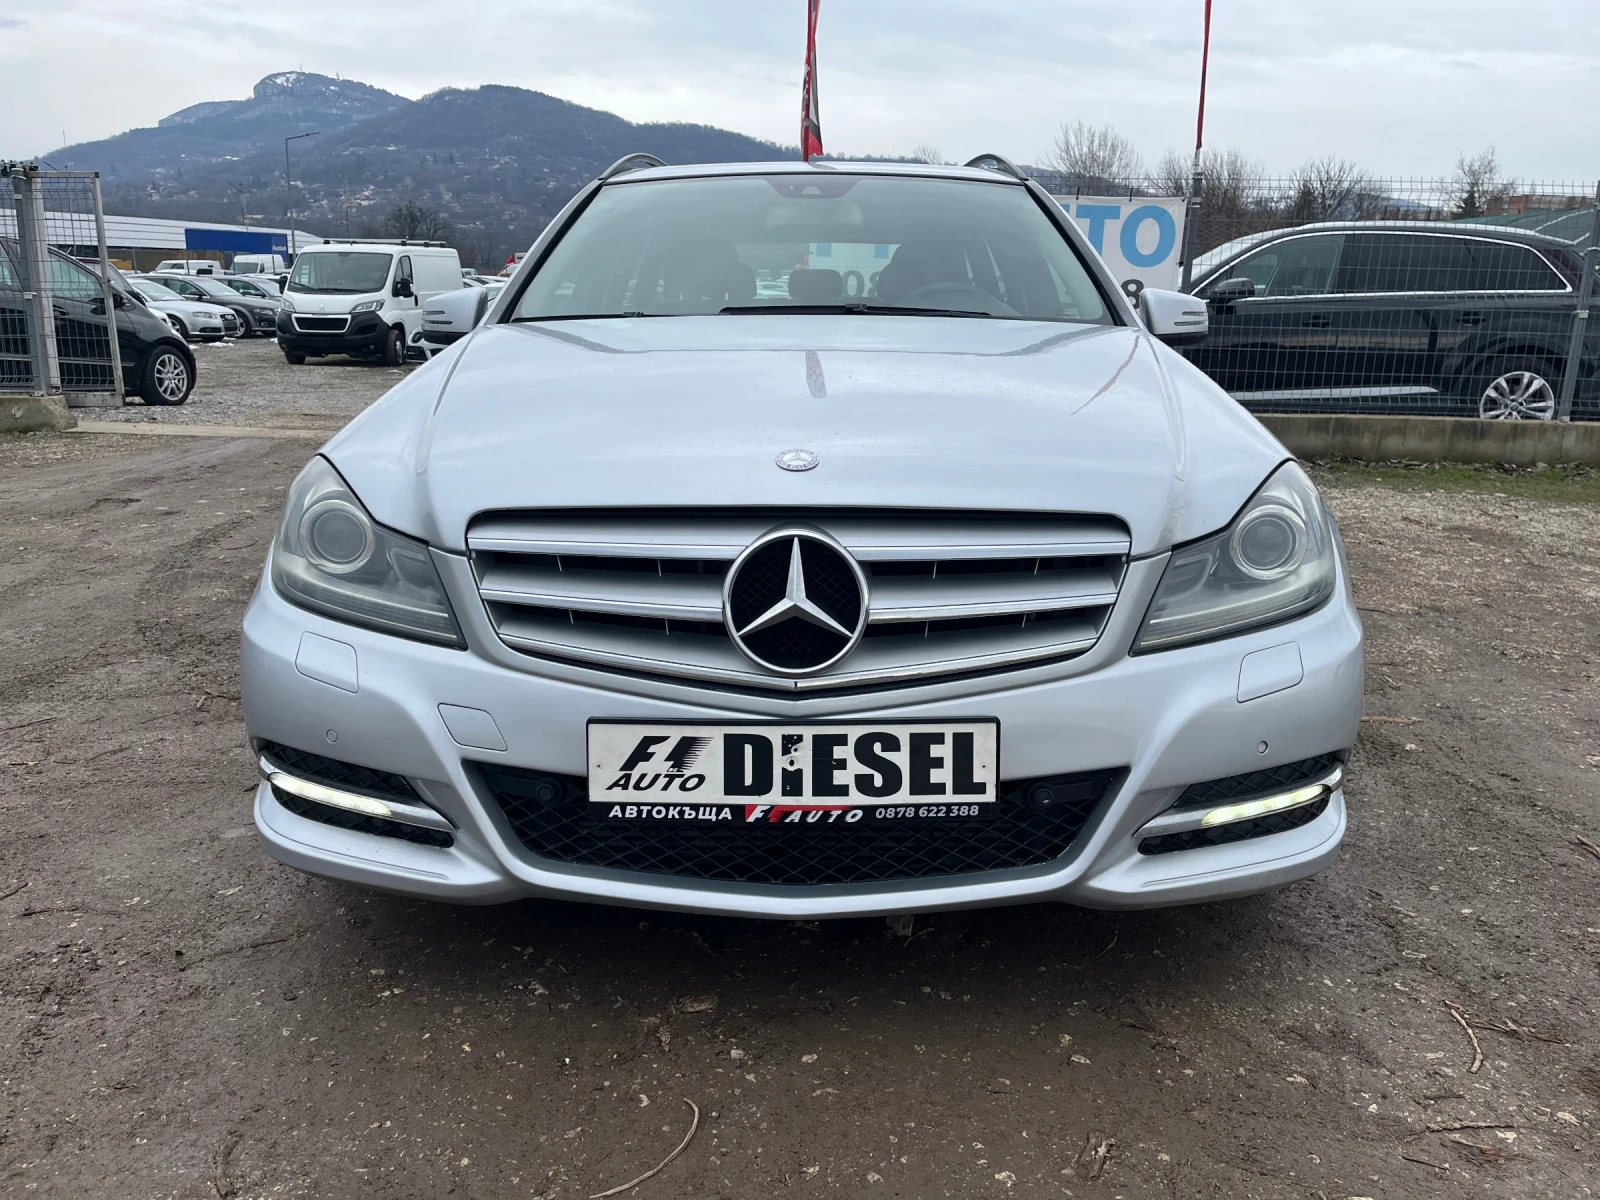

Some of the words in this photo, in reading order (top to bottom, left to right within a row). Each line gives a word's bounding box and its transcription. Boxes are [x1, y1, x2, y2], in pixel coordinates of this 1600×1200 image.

[1059, 204, 1177, 268] TO
[604, 773, 706, 793] AUTO
[723, 731, 987, 798] DIESEL
[608, 804, 733, 822] АВТОКЪЩА
[783, 809, 864, 823] AUTO
[875, 807, 915, 819] 0878
[918, 806, 947, 817] 622
[949, 804, 979, 817] 388
